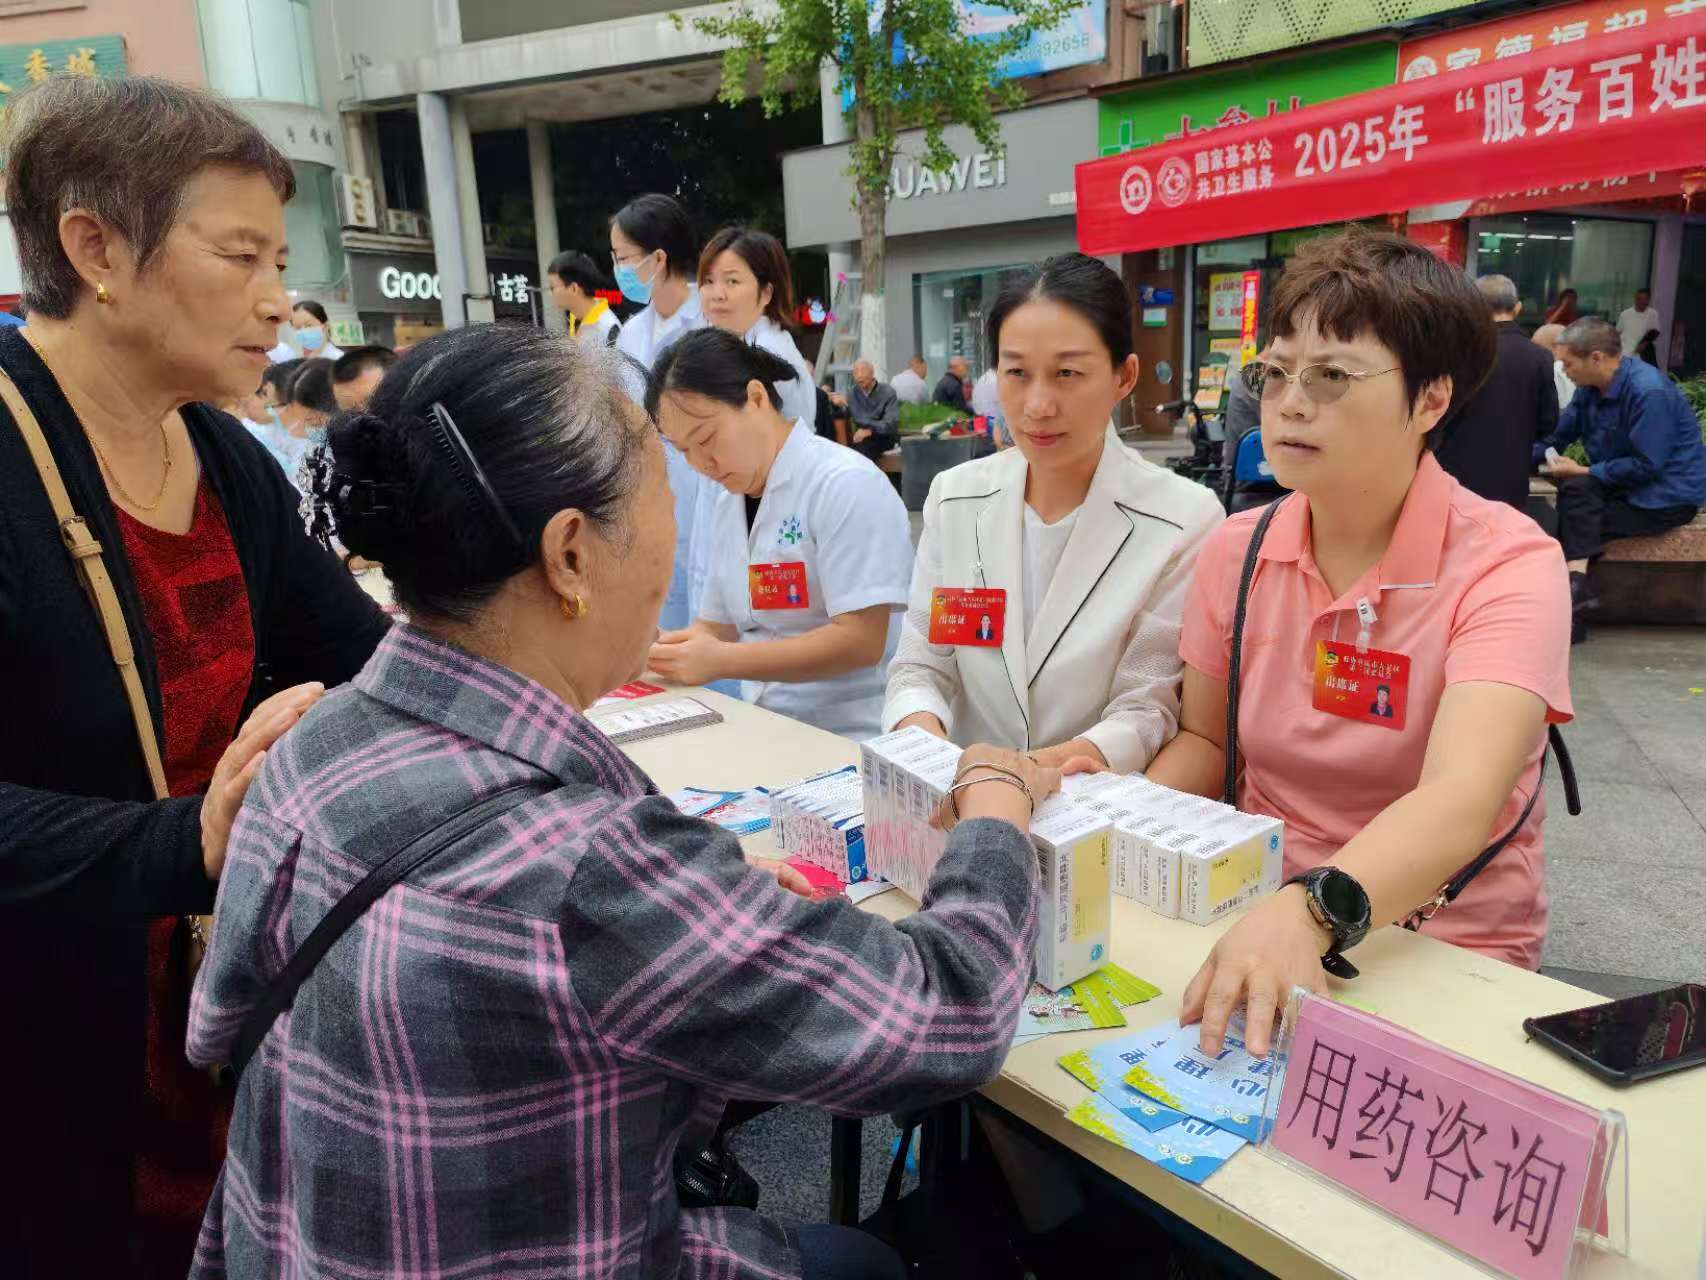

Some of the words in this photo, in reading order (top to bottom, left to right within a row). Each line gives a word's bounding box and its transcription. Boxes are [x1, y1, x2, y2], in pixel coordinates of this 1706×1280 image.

[1195, 137, 1273, 175] 国家基本公
[884, 150, 1007, 201] UAWEI
[1196, 165, 1275, 200] 共卫生服务
[497, 272, 529, 304] 古茗
[1286, 1036, 1567, 1257] 用药咨询
